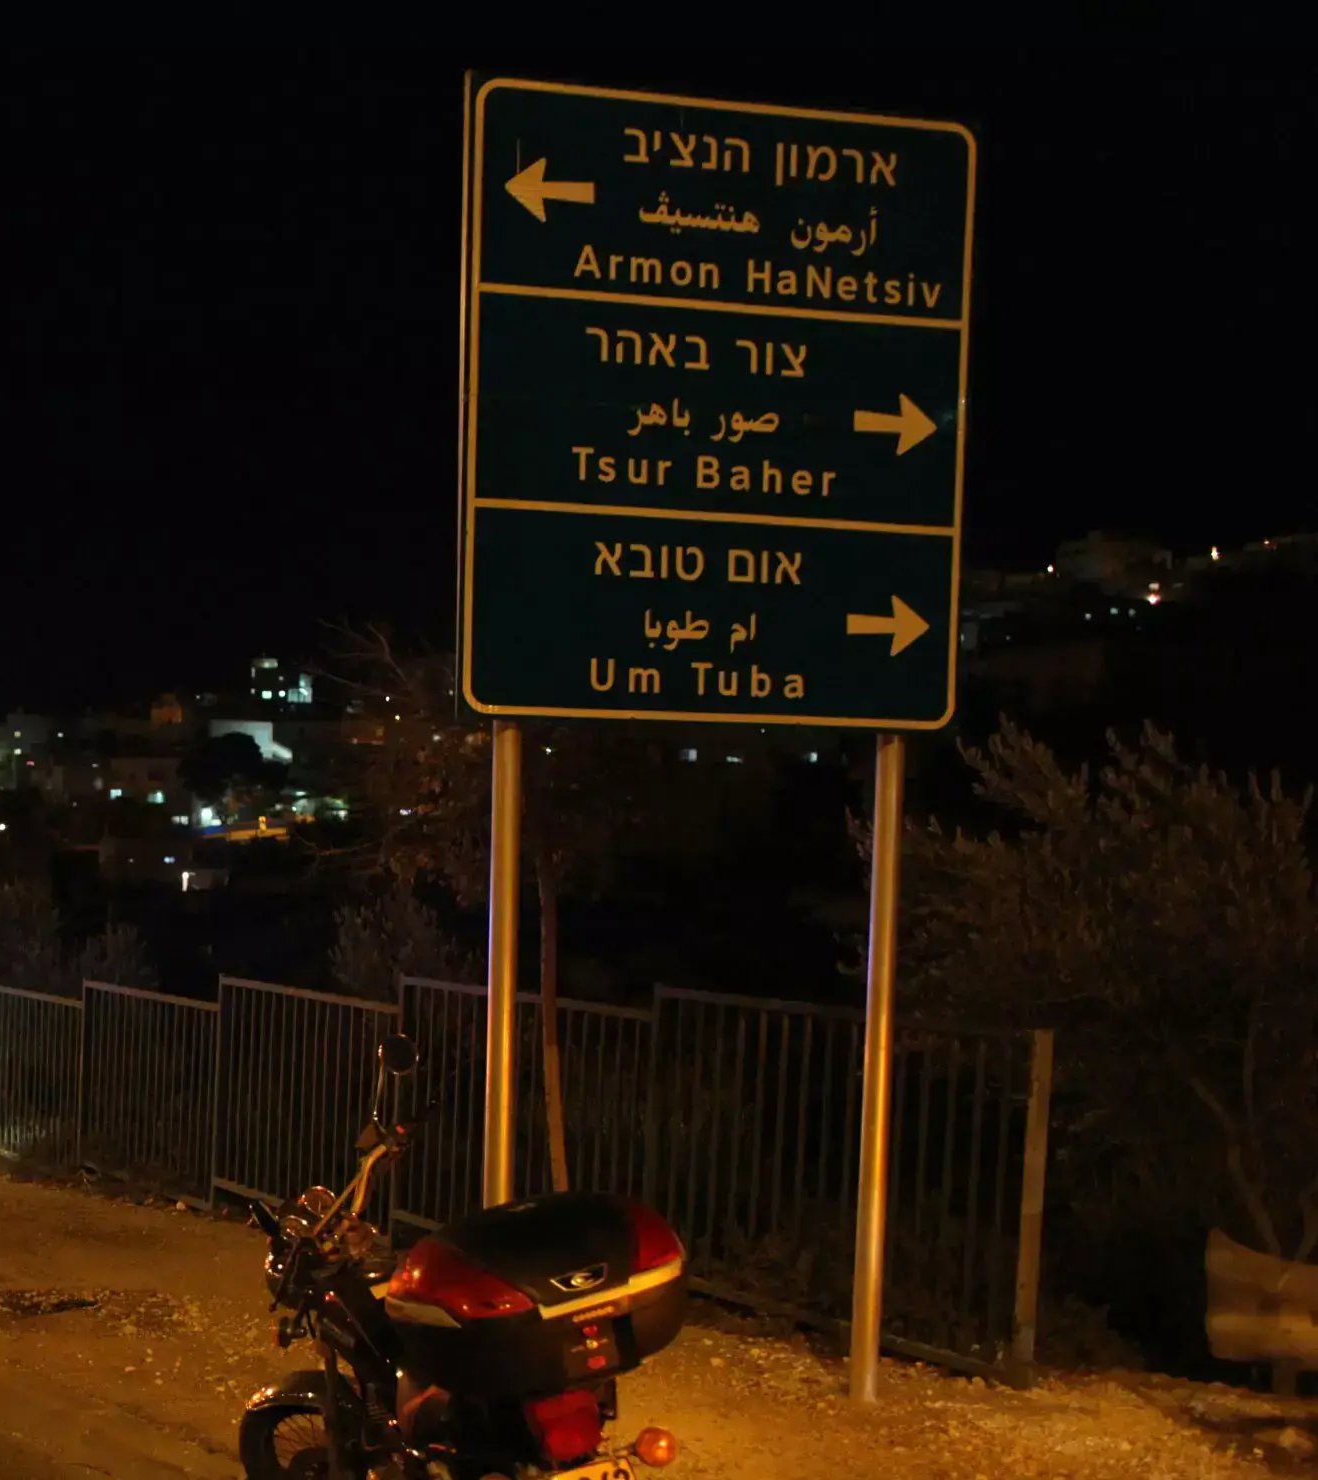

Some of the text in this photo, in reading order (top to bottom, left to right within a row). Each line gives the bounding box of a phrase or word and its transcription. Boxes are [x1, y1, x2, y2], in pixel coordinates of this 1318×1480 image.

[623, 128, 897, 186] ארמון הנציב
[790, 207, 878, 255] أرمون
[574, 244, 941, 308] Armon HaNetsiv
[586, 327, 807, 378] צור באהר
[627, 398, 780, 443] صور باهر
[571, 446, 836, 497] Tsur Baher
[594, 542, 802, 585] אום טובא
[644, 609, 710, 651] طوبا
[590, 657, 805, 699] Um Tuba
